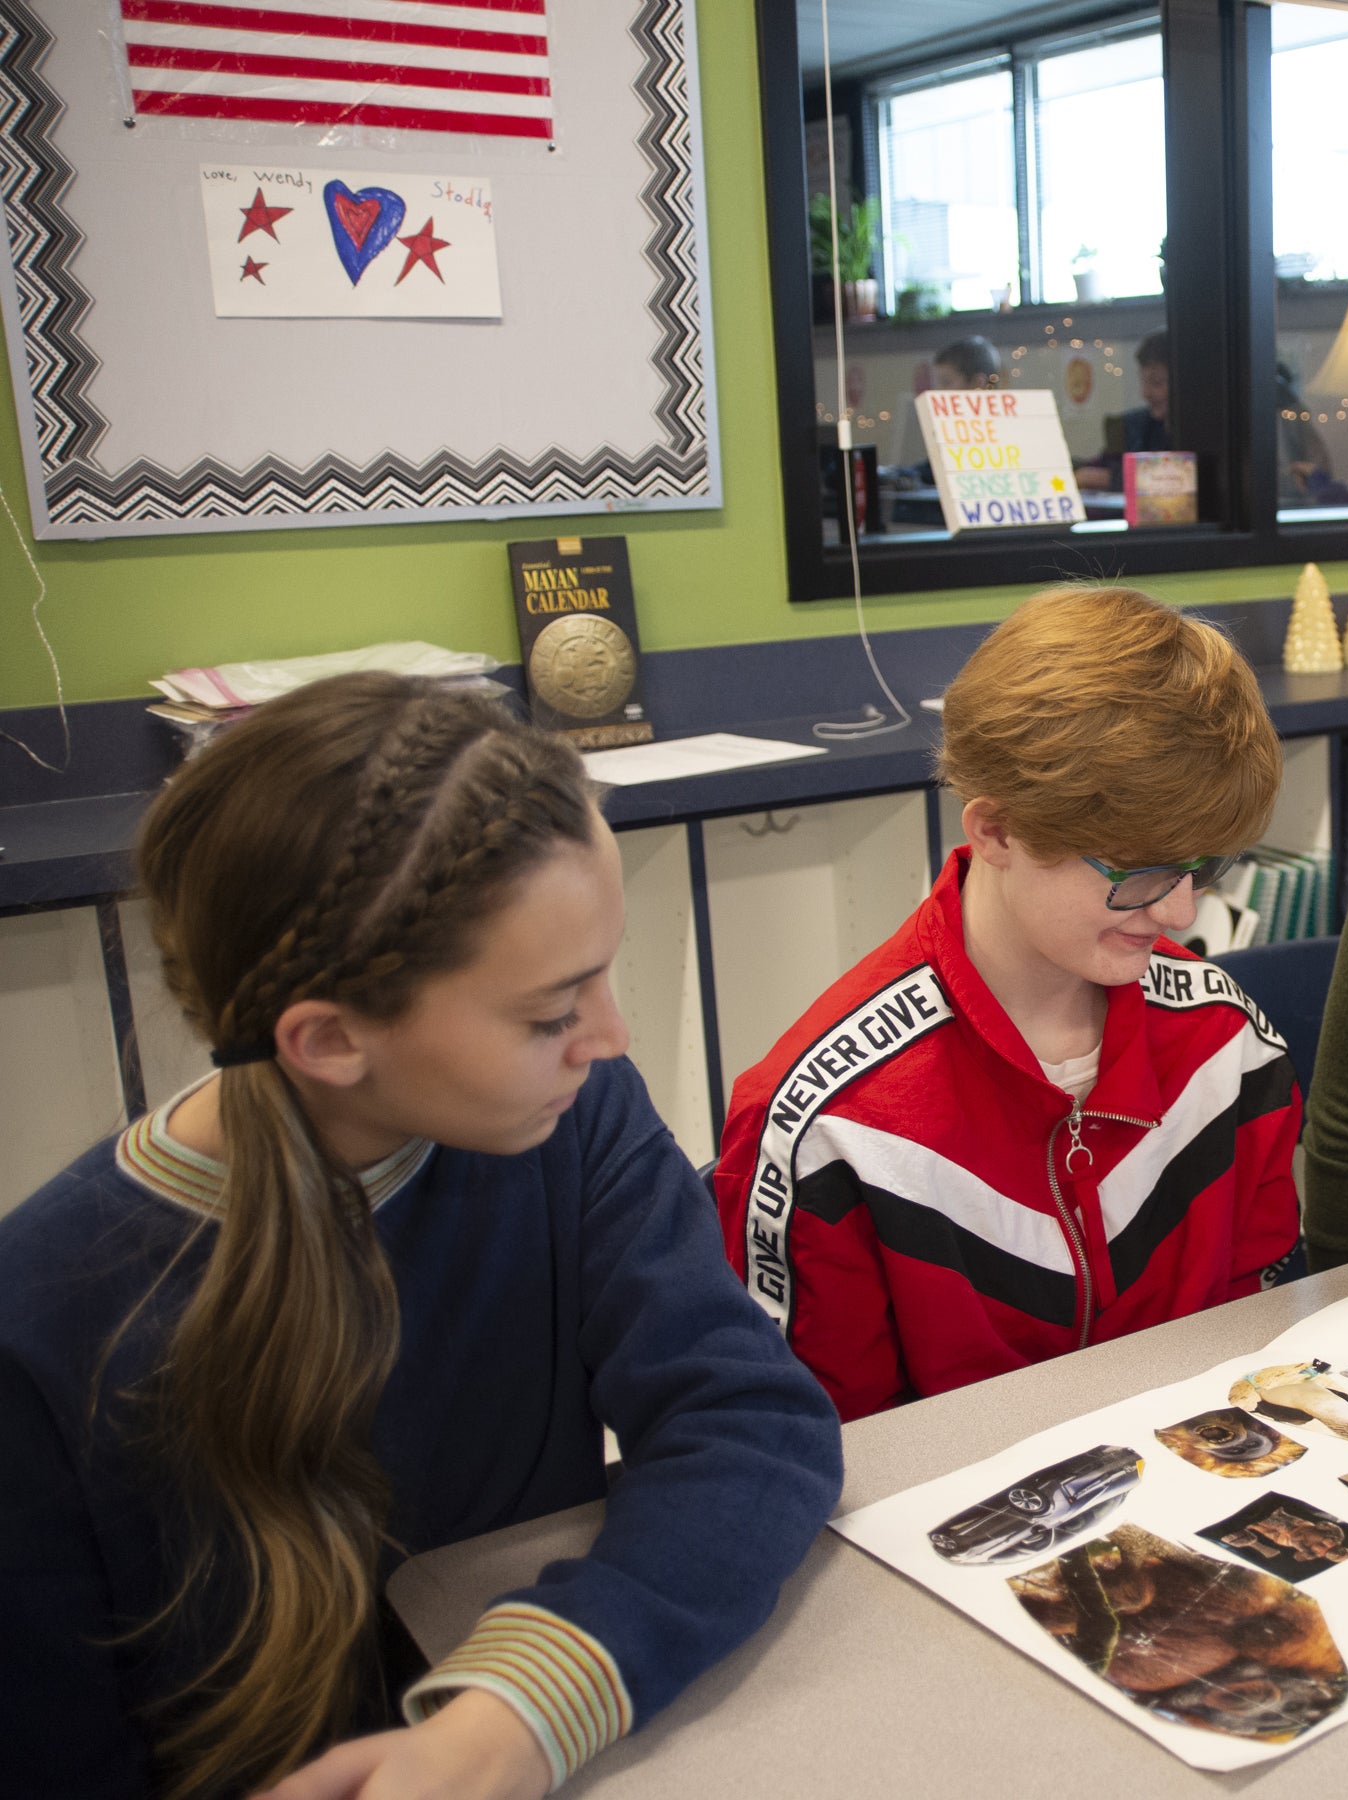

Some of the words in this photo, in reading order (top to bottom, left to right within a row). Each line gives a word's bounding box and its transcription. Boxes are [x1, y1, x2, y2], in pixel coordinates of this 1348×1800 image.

[253, 170, 314, 195] Wendy
[930, 394, 1018, 417] NEVER
[941, 418, 998, 445] LOSE
[946, 445, 1022, 471] YOUR
[955, 475, 1012, 497] SENSE
[1018, 472, 1041, 496] OF
[960, 496, 1075, 524] WONDER
[522, 567, 579, 593] MAYAN
[525, 587, 611, 615] CALENDAR
[858, 983, 939, 1051] GIVE
[771, 1034, 869, 1135] NEVER
[756, 1162, 788, 1219] UP
[754, 1219, 786, 1304] GIVE
